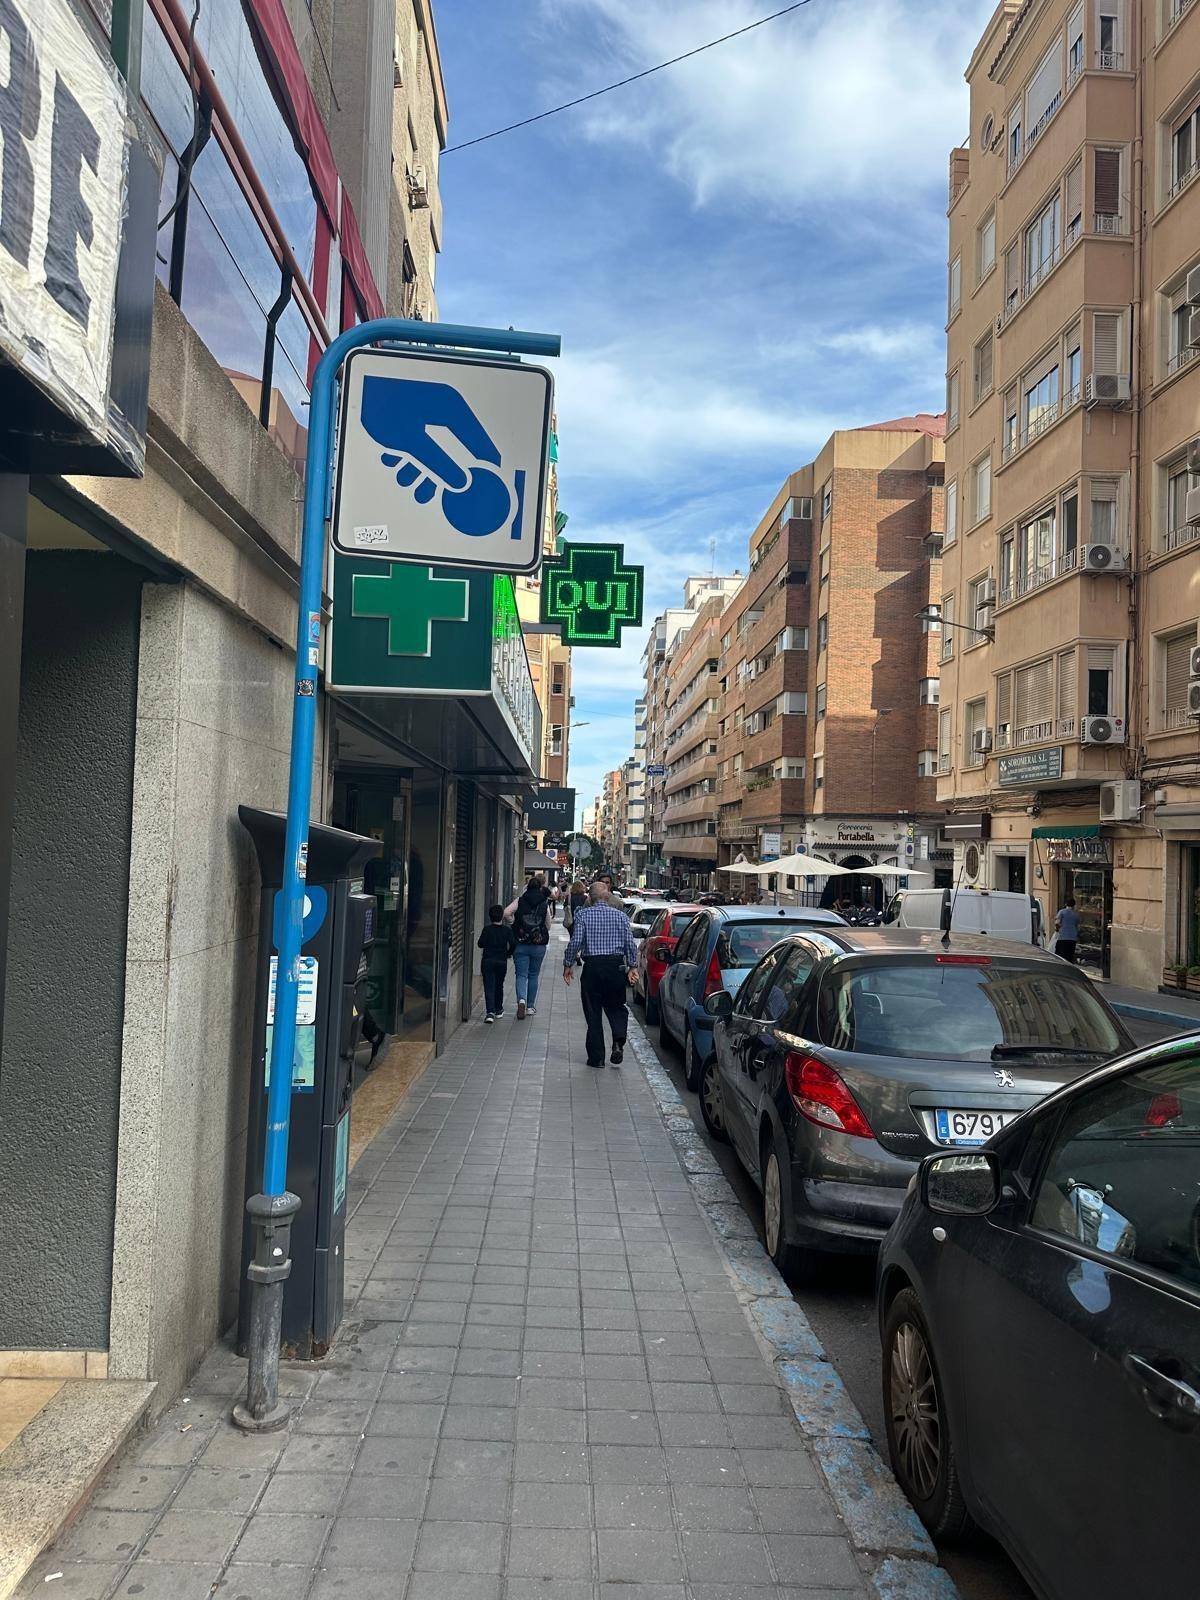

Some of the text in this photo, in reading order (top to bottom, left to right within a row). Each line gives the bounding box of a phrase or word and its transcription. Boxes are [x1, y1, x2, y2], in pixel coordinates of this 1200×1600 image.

[532, 801, 568, 810] OUTLET
[838, 832, 875, 841] Portabella
[941, 1126, 947, 1134] E
